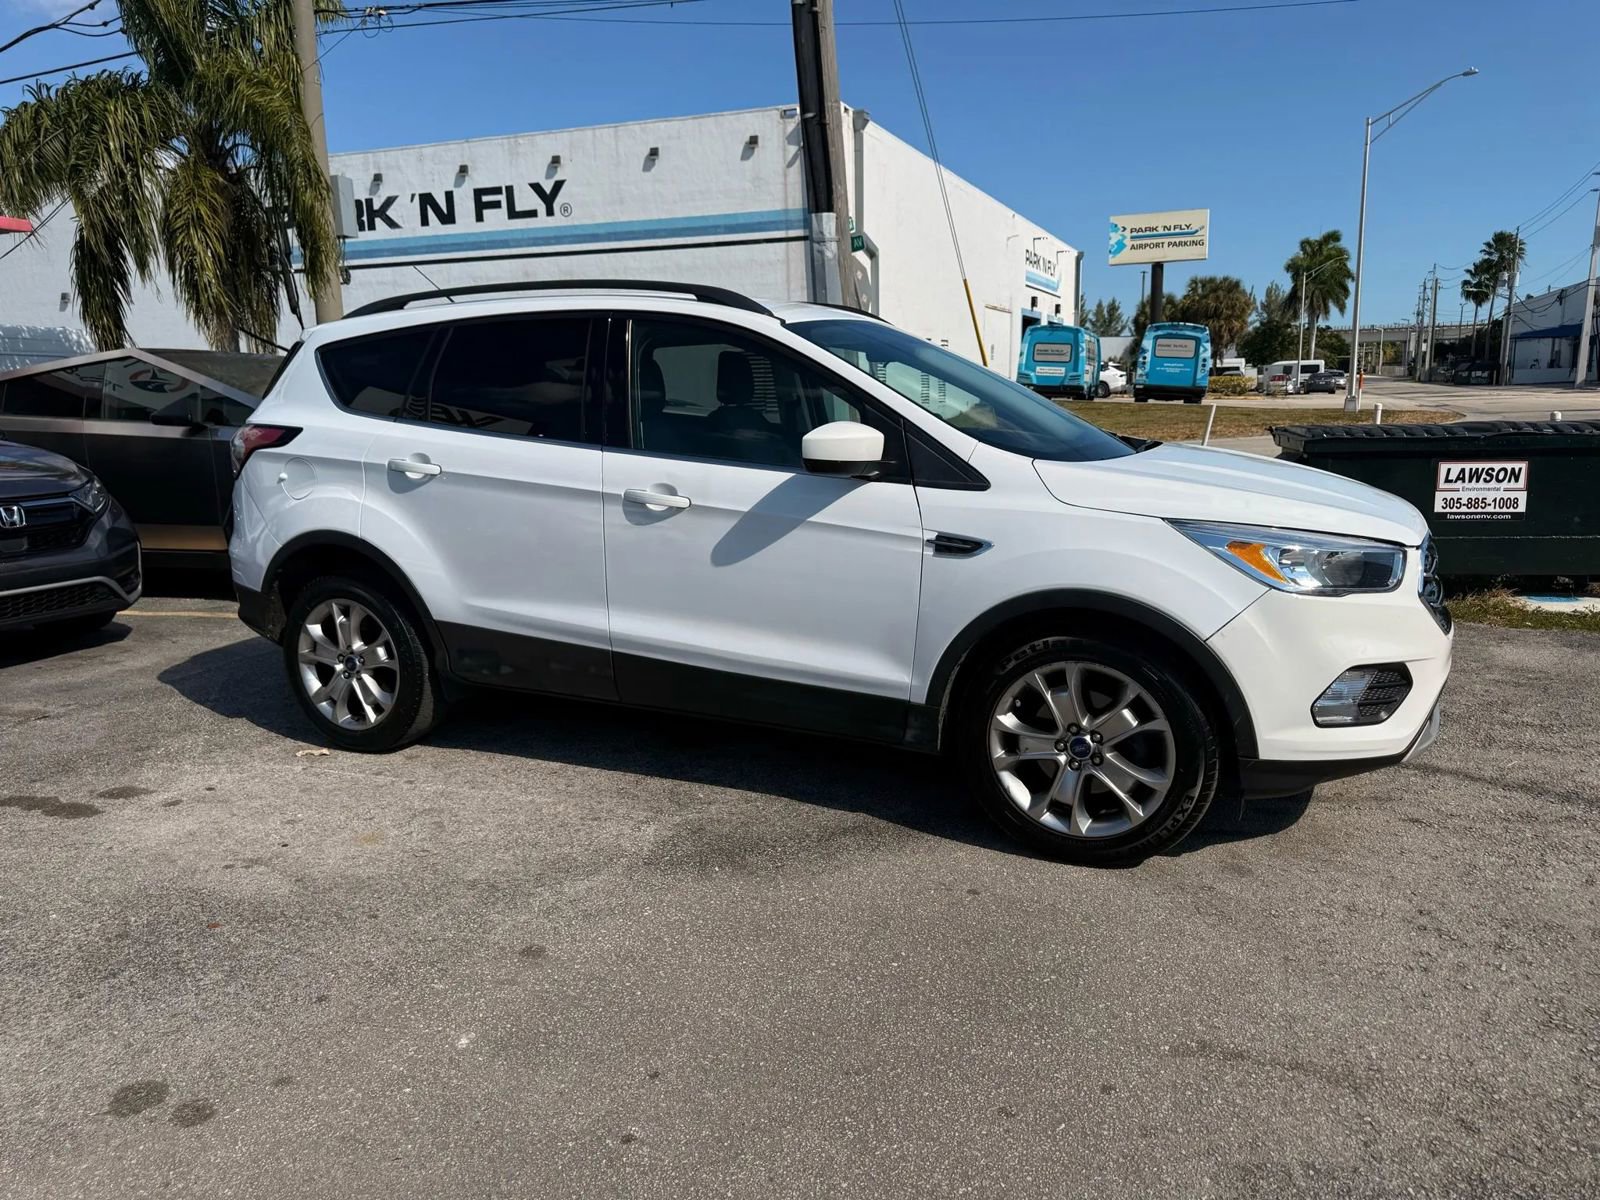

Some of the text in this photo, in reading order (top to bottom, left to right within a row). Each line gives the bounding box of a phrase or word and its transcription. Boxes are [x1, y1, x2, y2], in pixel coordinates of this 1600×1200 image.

[1130, 226, 1160, 235] PARK
[1130, 239, 1205, 251] AIRPORT PARKING
[1444, 467, 1523, 484] LAWSON
[1441, 497, 1519, 510] 305-885-1008
